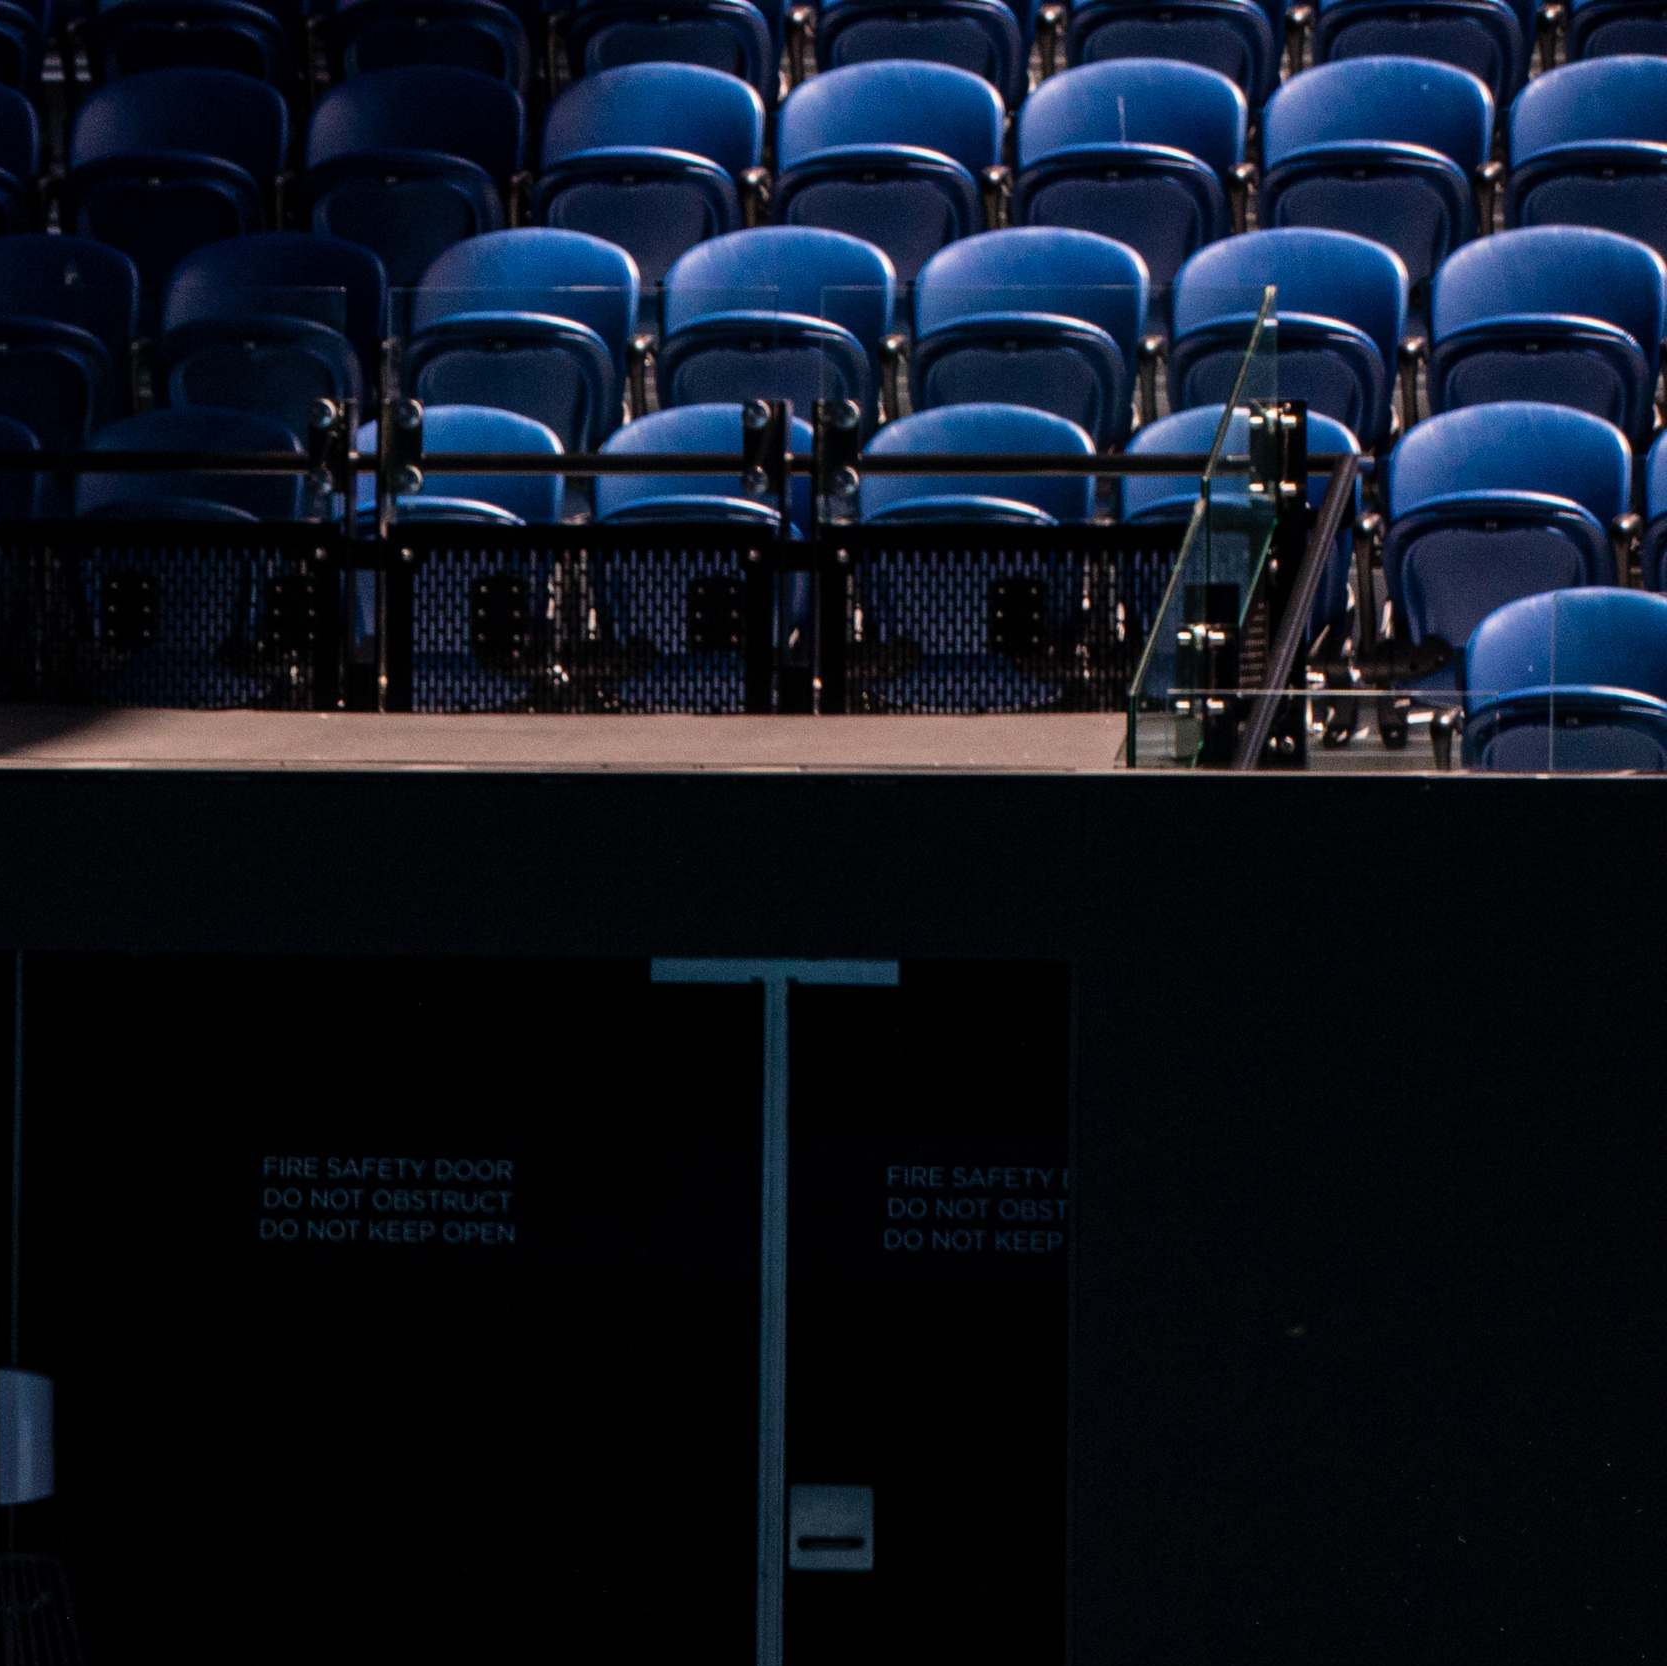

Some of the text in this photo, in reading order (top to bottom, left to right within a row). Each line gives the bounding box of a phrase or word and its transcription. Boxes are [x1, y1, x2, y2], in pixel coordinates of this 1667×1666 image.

[263, 1156, 515, 1182] FIRE SAFETY DOOR
[887, 1166, 945, 1188] FIRE
[952, 1167, 1054, 1190] SAFETY
[263, 1187, 514, 1213] DO NOT OBSTRUCT
[888, 1197, 928, 1220] DO
[935, 1198, 991, 1220] NOT
[259, 1218, 516, 1244] DO NOT KEEP OPEN
[883, 1228, 1064, 1253] DO NOT KEEP
